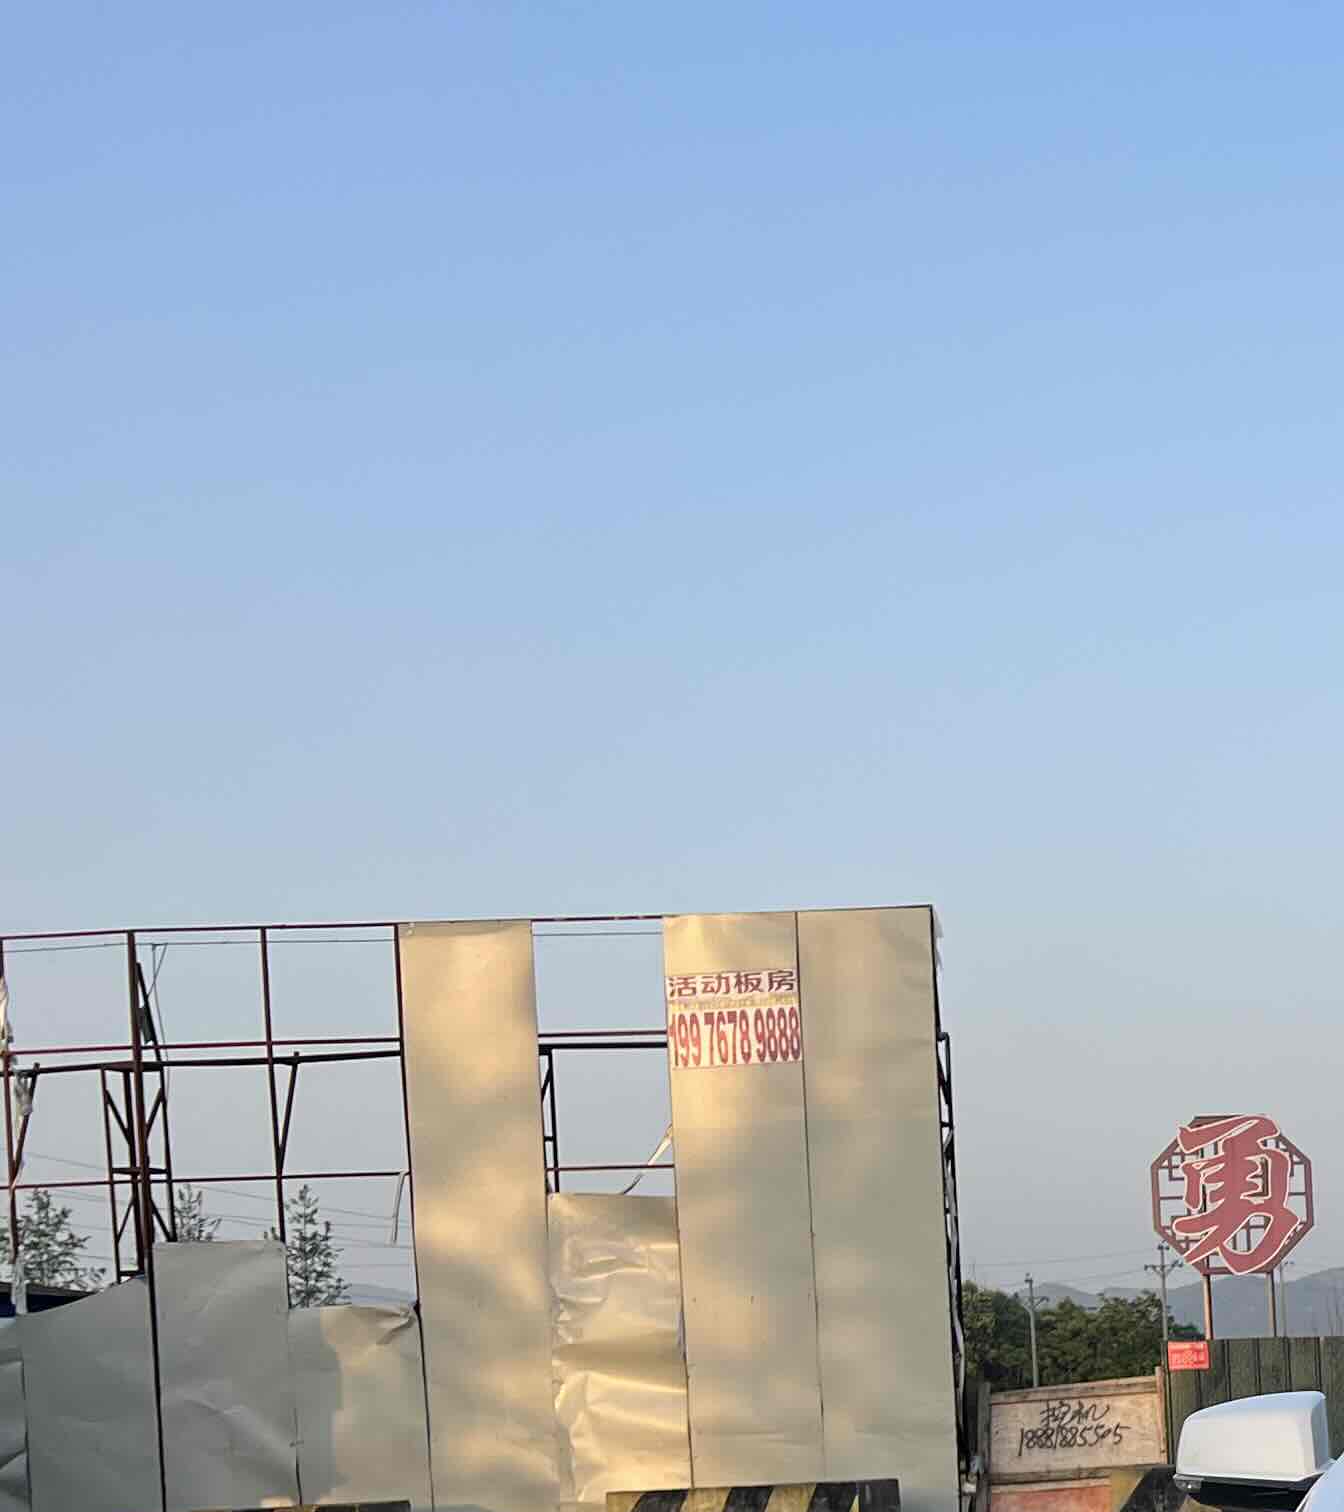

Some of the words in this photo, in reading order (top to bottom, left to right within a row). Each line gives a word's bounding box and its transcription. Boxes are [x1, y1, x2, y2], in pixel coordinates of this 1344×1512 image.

[668, 970, 797, 997] 活动板房
[668, 1012, 702, 1067] 199
[703, 1009, 752, 1065] 7678
[753, 1006, 801, 1062] 9888
[1172, 1114, 1301, 1276] 勇
